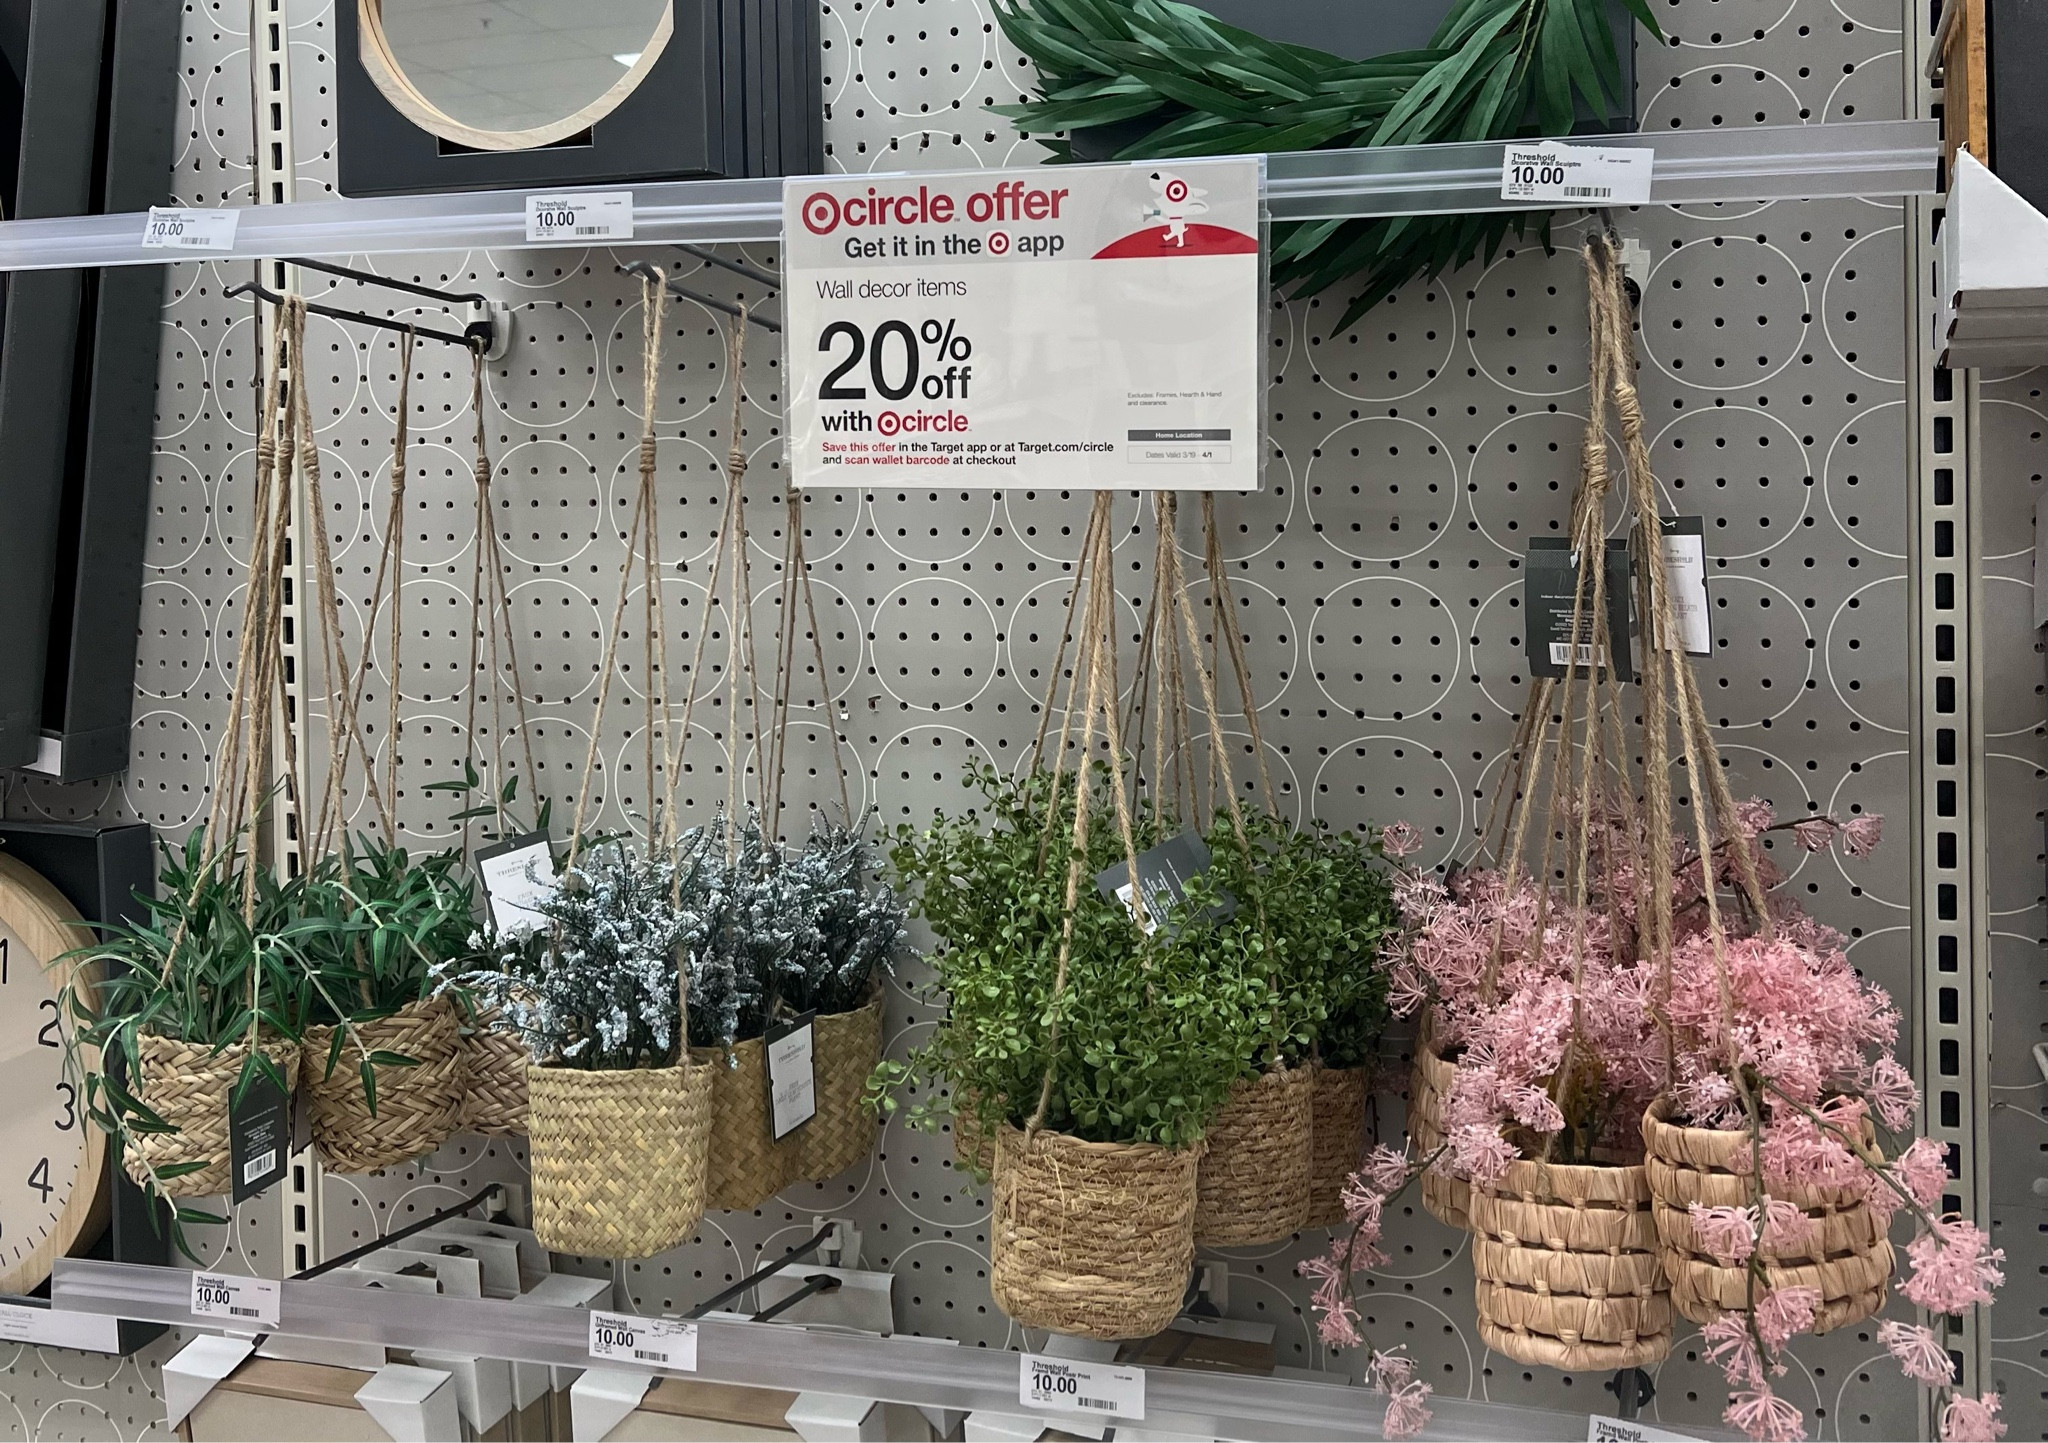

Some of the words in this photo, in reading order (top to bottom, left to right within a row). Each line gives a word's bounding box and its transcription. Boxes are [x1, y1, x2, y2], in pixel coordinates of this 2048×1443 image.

[1512, 153, 1556, 162] Threshold
[1512, 166, 1564, 184] 10.00
[536, 201, 568, 209] Threshold
[843, 186, 955, 226] circle
[966, 181, 1069, 222] offer
[536, 211, 575, 227] 10.00
[152, 222, 184, 236] 10.00
[845, 237, 886, 258] Get
[893, 235, 908, 257] it
[915, 235, 935, 256] in
[942, 234, 982, 255] the
[1017, 234, 1065, 257] app
[816, 279, 853, 299] Wall
[858, 279, 912, 298] decor
[916, 278, 967, 296] items
[921, 366, 972, 400] off
[821, 410, 872, 431] with
[902, 409, 969, 432] circle
[822, 442, 847, 452] Save
[850, 442, 869, 452] this
[871, 442, 896, 452] offer
[899, 442, 908, 452] in
[911, 442, 928, 452] the
[930, 442, 964, 454] Target
[966, 443, 987, 454] app
[990, 444, 1001, 452] or
[1004, 442, 1015, 452] at
[1017, 441, 1114, 454] Target.com/circle
[1165, 451, 1181, 459] Valid
[1202, 451, 1212, 459] 4/1
[822, 455, 842, 465] and
[844, 456, 870, 465] scan
[872, 455, 904, 465] wallet
[906, 455, 950, 465] barcode
[952, 455, 963, 465] at
[966, 455, 1017, 465] checkout
[0, 938, 9, 984] 1
[38, 999, 61, 1048] 2
[54, 1082, 76, 1131] 3
[28, 1157, 54, 1203] 4
[197, 1277, 225, 1287] Threshold
[196, 1287, 230, 1304] 10.00
[595, 1316, 628, 1327] Threshold
[595, 1328, 634, 1347] 10.00
[1032, 1361, 1069, 1372] Threshold
[1032, 1373, 1077, 1395] 10.00
[1597, 1421, 1641, 1439] Threshold
